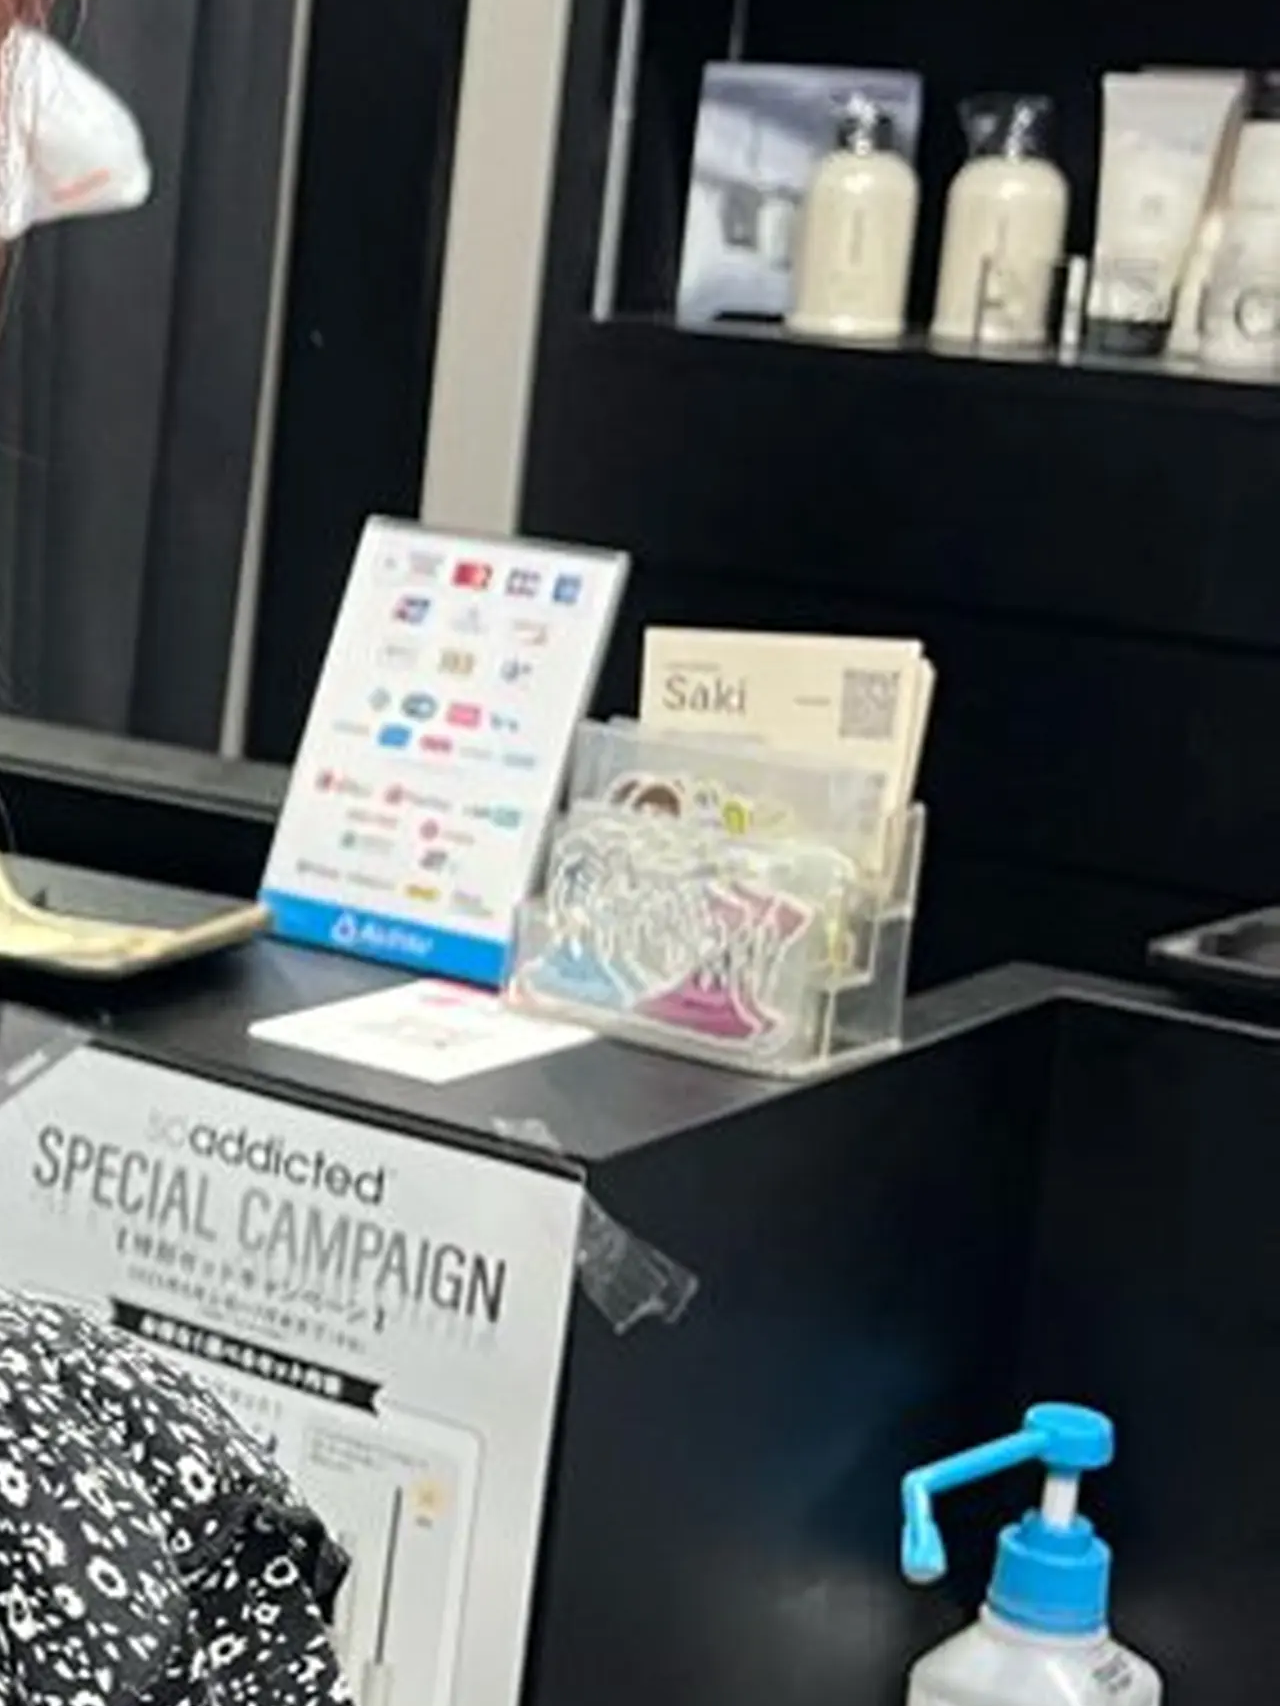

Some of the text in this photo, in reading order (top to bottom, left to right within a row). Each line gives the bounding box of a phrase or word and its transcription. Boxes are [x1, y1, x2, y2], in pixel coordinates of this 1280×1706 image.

[659, 672, 748, 715] Saki
[31, 1124, 219, 1244] SPECIAL
[238, 1185, 508, 1325] CAMPAIGN
